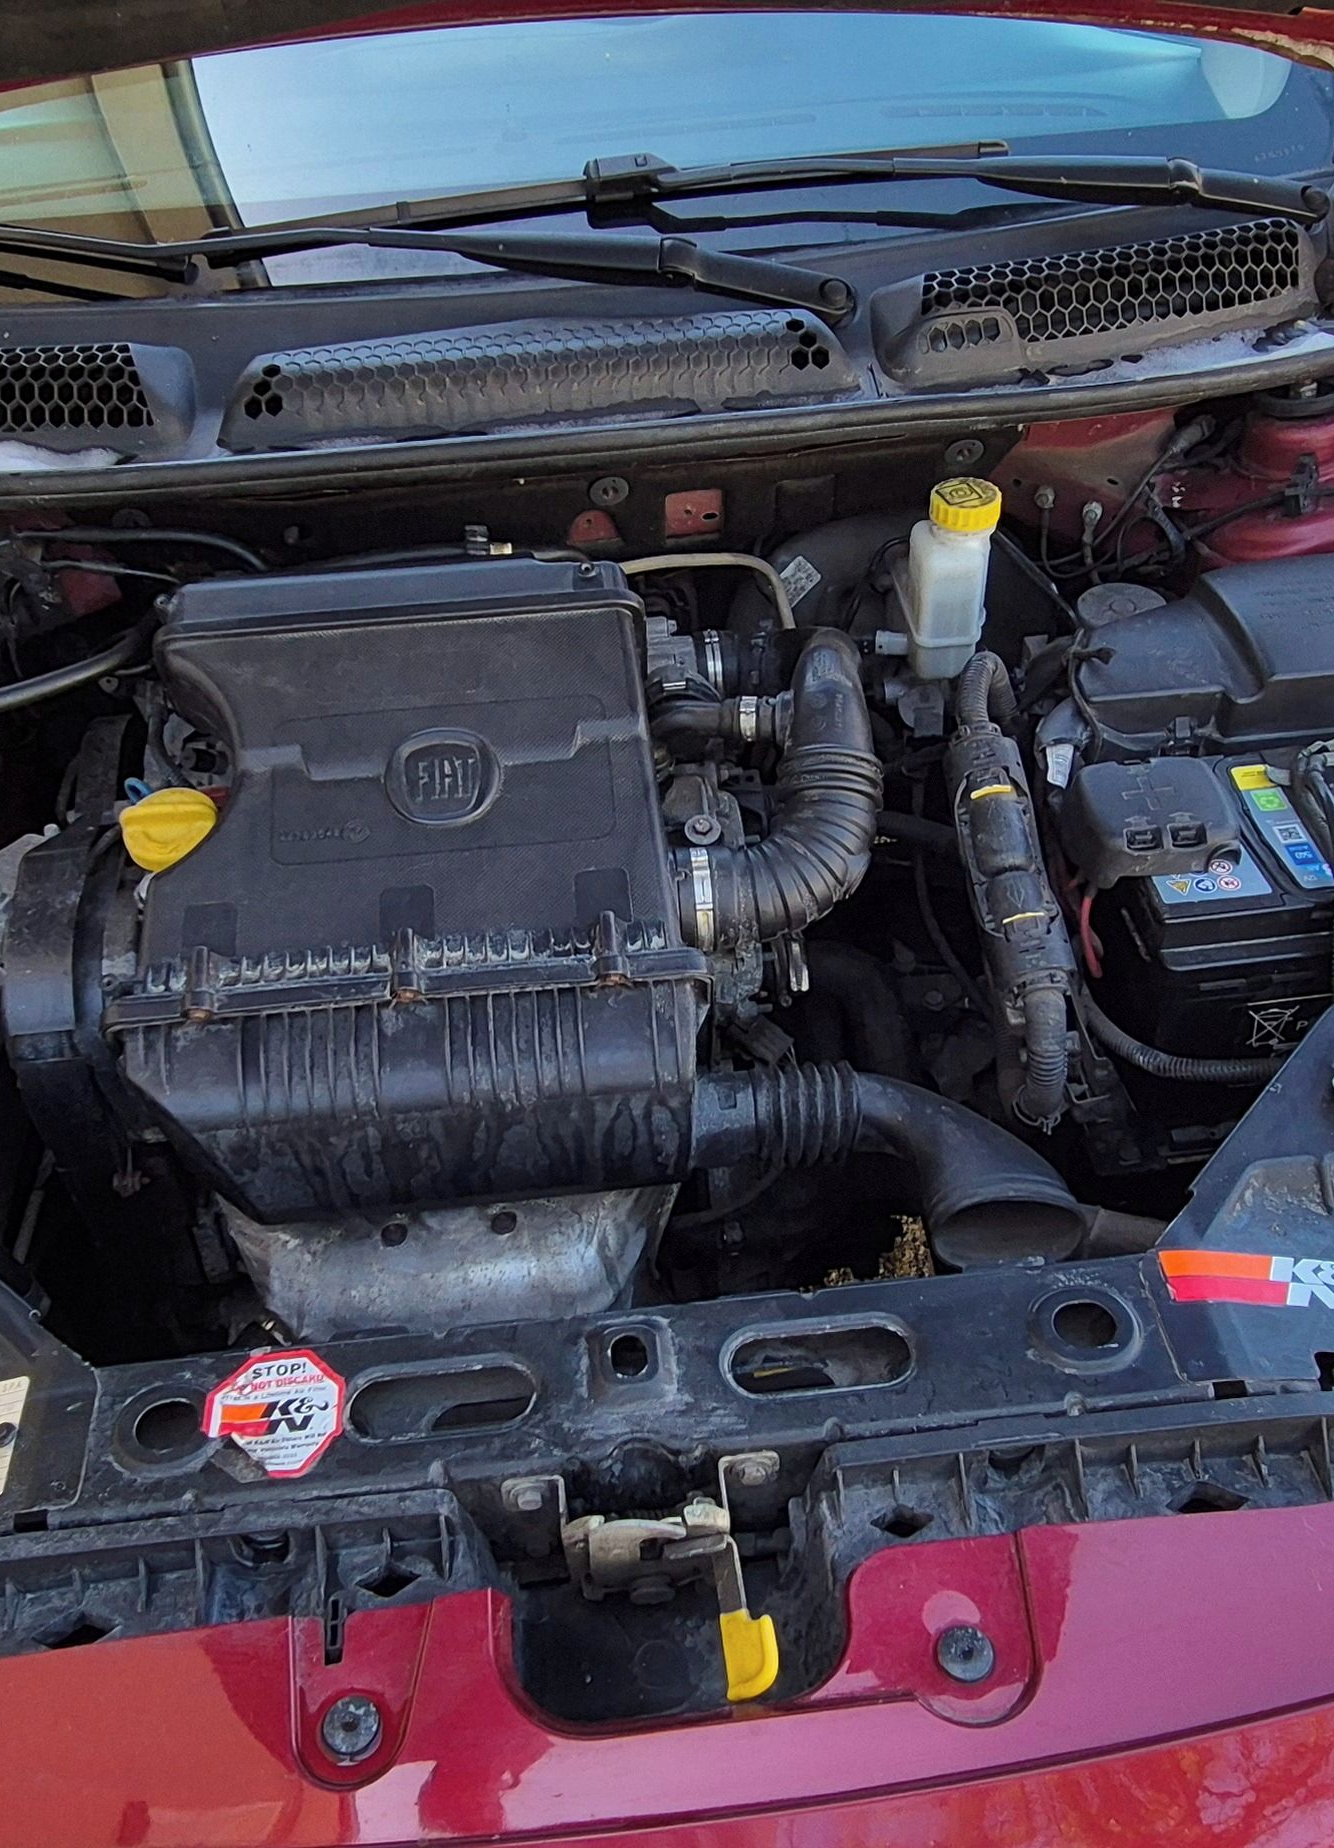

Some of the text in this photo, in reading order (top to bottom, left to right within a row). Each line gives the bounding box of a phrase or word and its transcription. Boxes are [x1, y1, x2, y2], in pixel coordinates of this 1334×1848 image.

[415, 756, 476, 802] FIAT
[252, 1362, 307, 1380] STOP!
[251, 1380, 273, 1392] NOT
[259, 1397, 329, 1436] K&N
